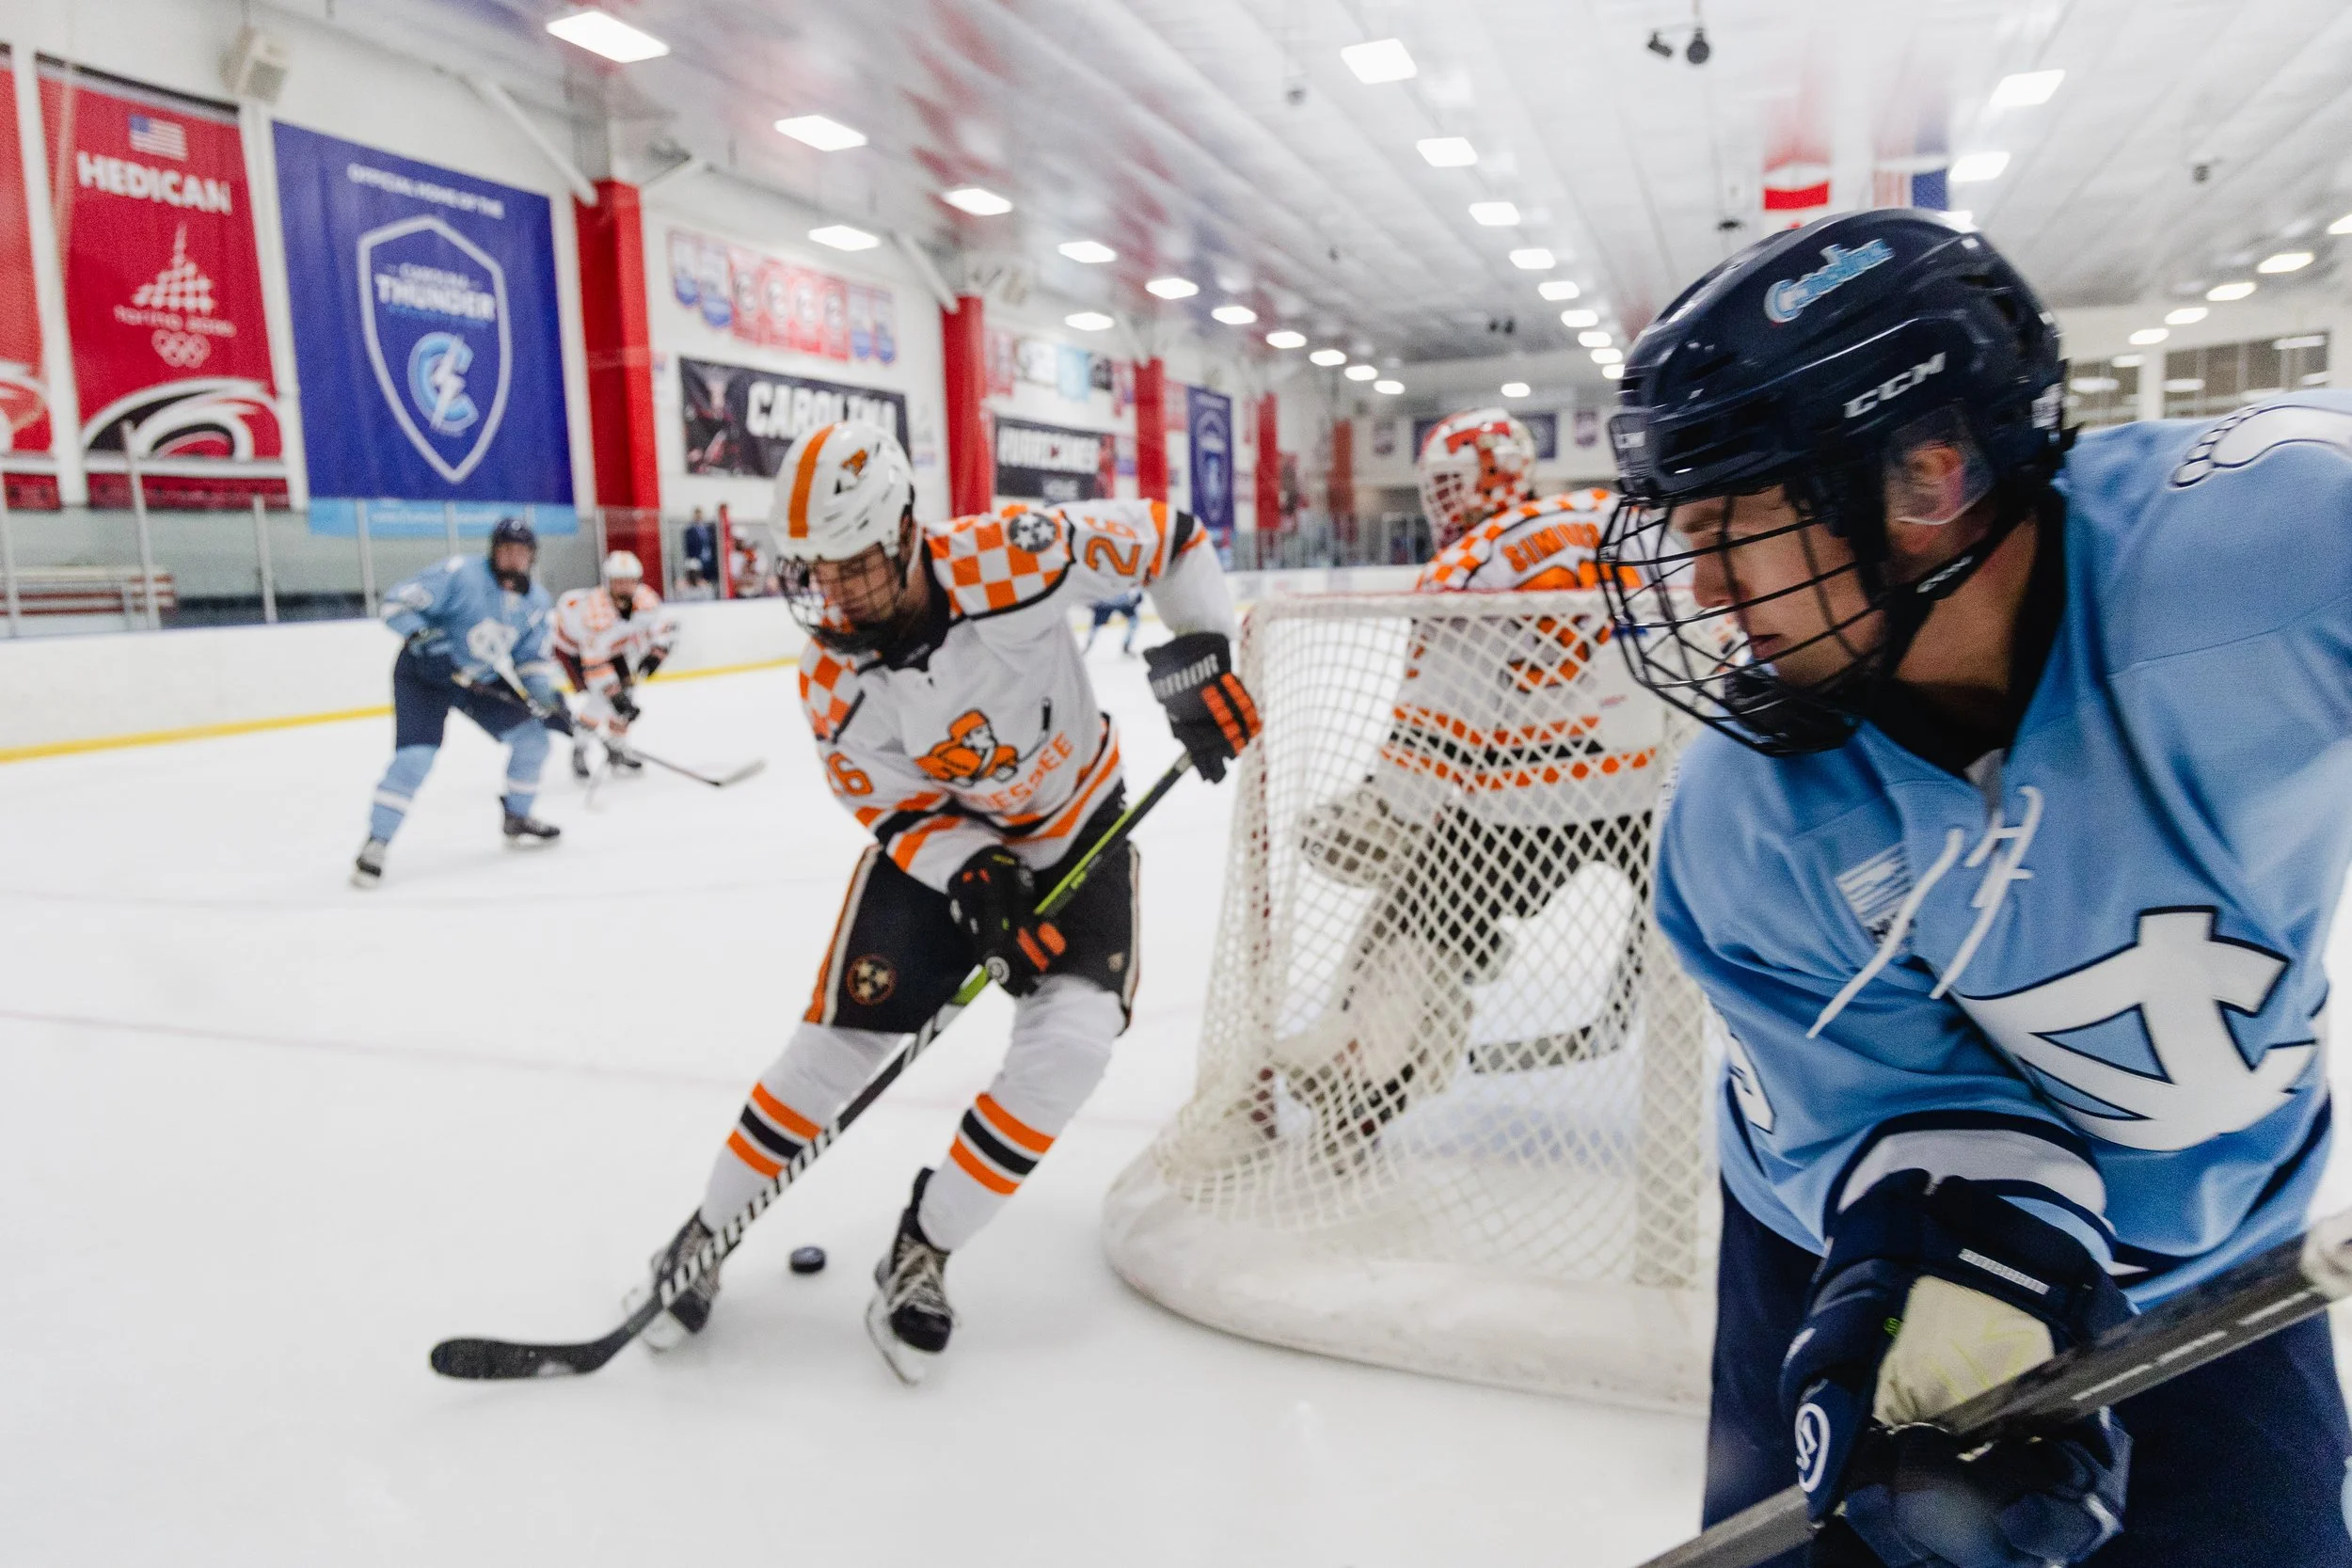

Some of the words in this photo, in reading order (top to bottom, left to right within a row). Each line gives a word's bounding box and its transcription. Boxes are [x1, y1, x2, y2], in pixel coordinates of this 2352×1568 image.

[77, 150, 231, 215] HEDICAN
[375, 274, 496, 322] THUNDER
[1843, 352, 1947, 419] CCM
[997, 424, 1101, 475] HURRICANES
